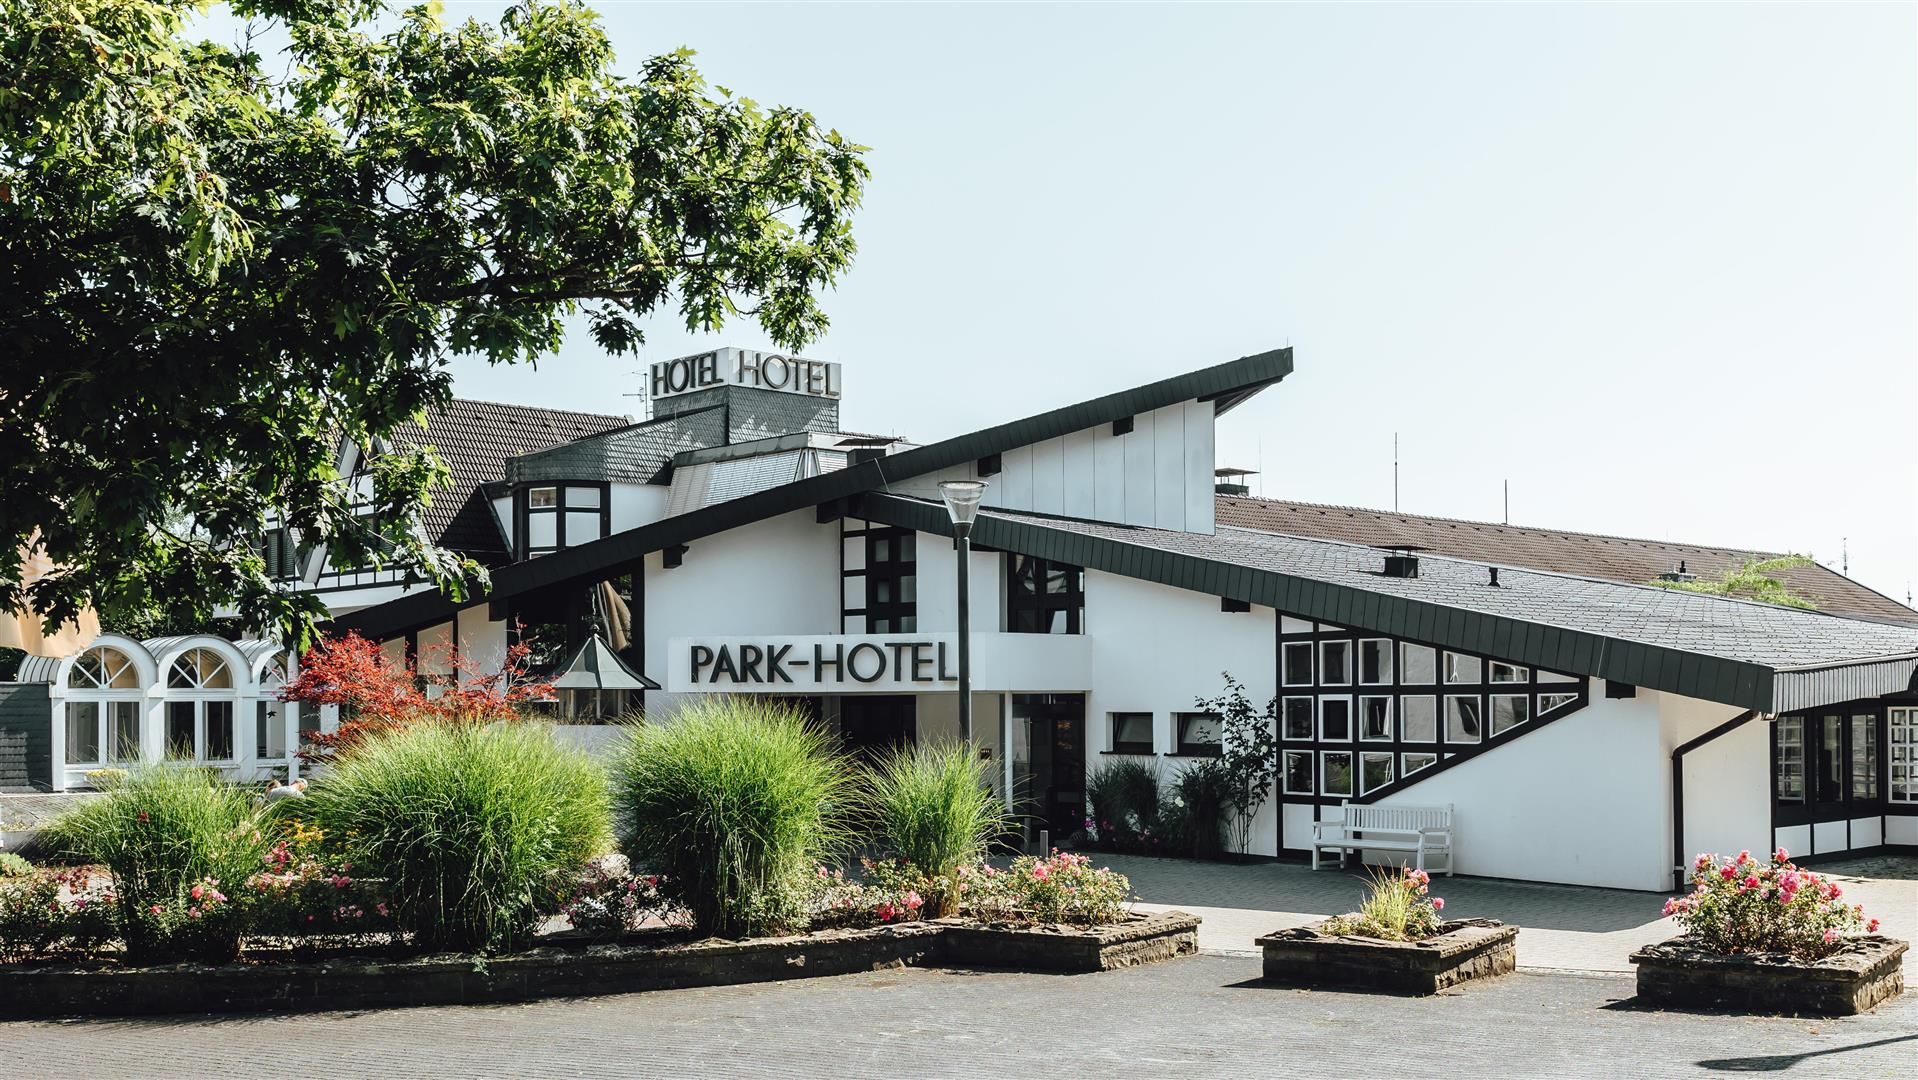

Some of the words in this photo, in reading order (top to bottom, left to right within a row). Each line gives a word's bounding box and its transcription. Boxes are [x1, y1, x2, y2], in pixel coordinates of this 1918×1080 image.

[652, 351, 724, 396] HOTEL
[739, 350, 840, 396] HOTEL
[690, 641, 958, 683] PARK-HOTEL
